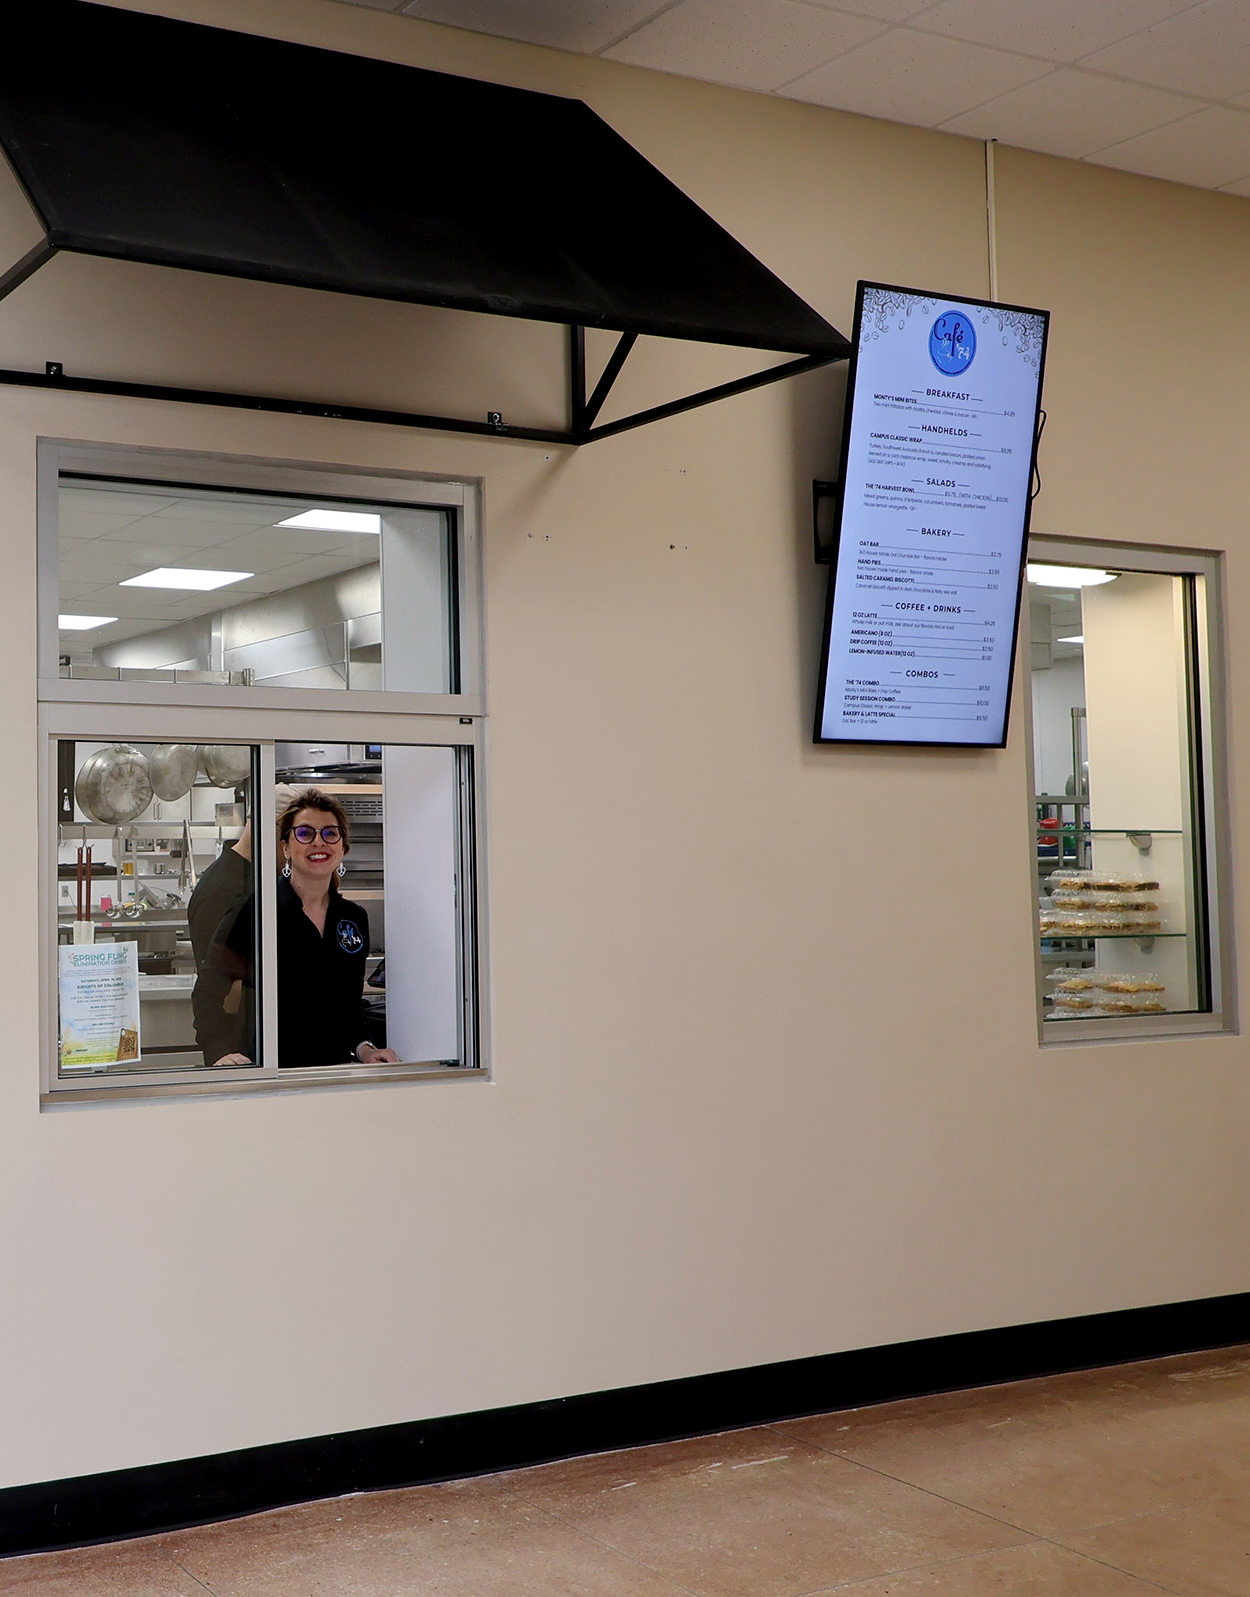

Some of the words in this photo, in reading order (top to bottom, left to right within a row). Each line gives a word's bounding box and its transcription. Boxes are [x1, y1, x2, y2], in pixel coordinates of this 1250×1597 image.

[934, 318, 963, 356] Café
[874, 393, 894, 401] MONTY'S
[926, 388, 970, 400] BREAKFAST
[921, 424, 968, 437] HANDHELDS
[926, 478, 956, 488] SALADS
[921, 527, 951, 537] BAKERY
[895, 602, 924, 611] COFFEE
[933, 605, 961, 613] DRINKS
[905, 669, 938, 678] COMBOS
[73, 953, 105, 961] SPRING
